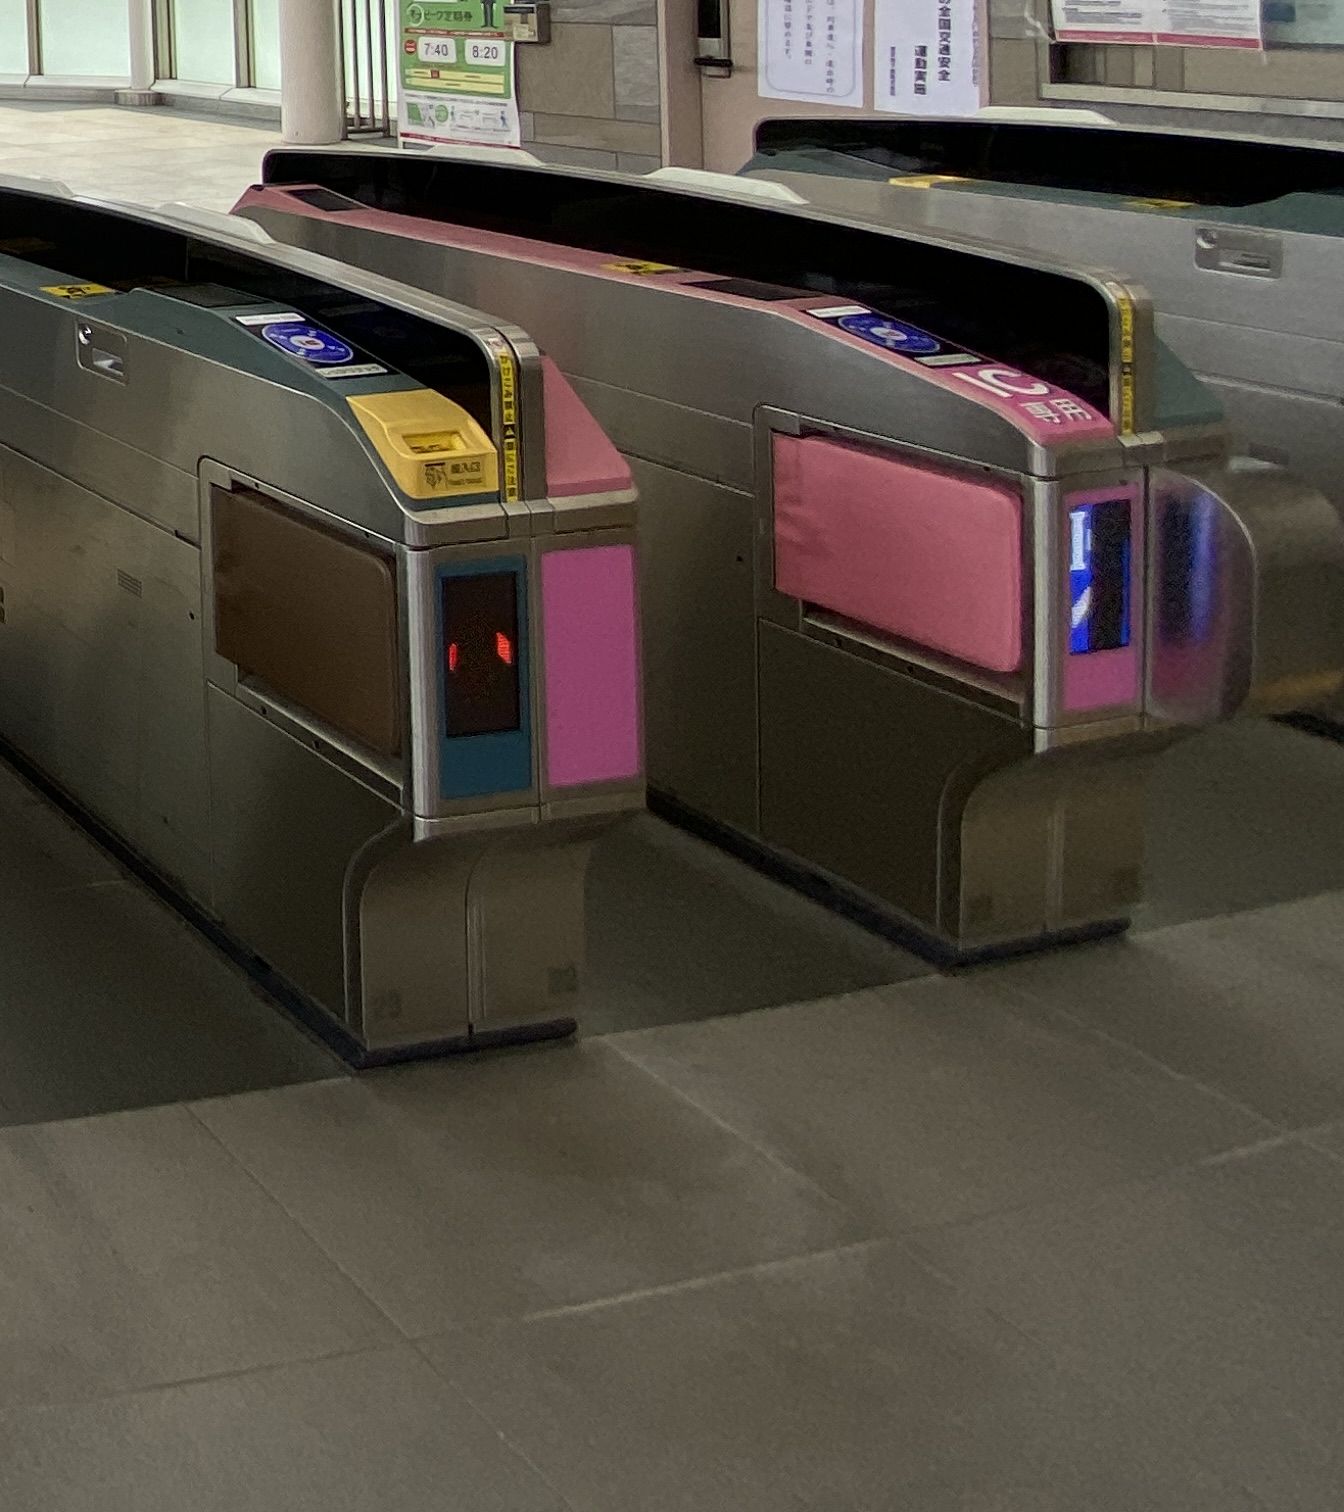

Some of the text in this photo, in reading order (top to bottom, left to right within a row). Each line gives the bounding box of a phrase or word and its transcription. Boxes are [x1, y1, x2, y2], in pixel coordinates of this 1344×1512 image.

[424, 43, 499, 59] 7:40 8:20
[952, 368, 1050, 399] IC
